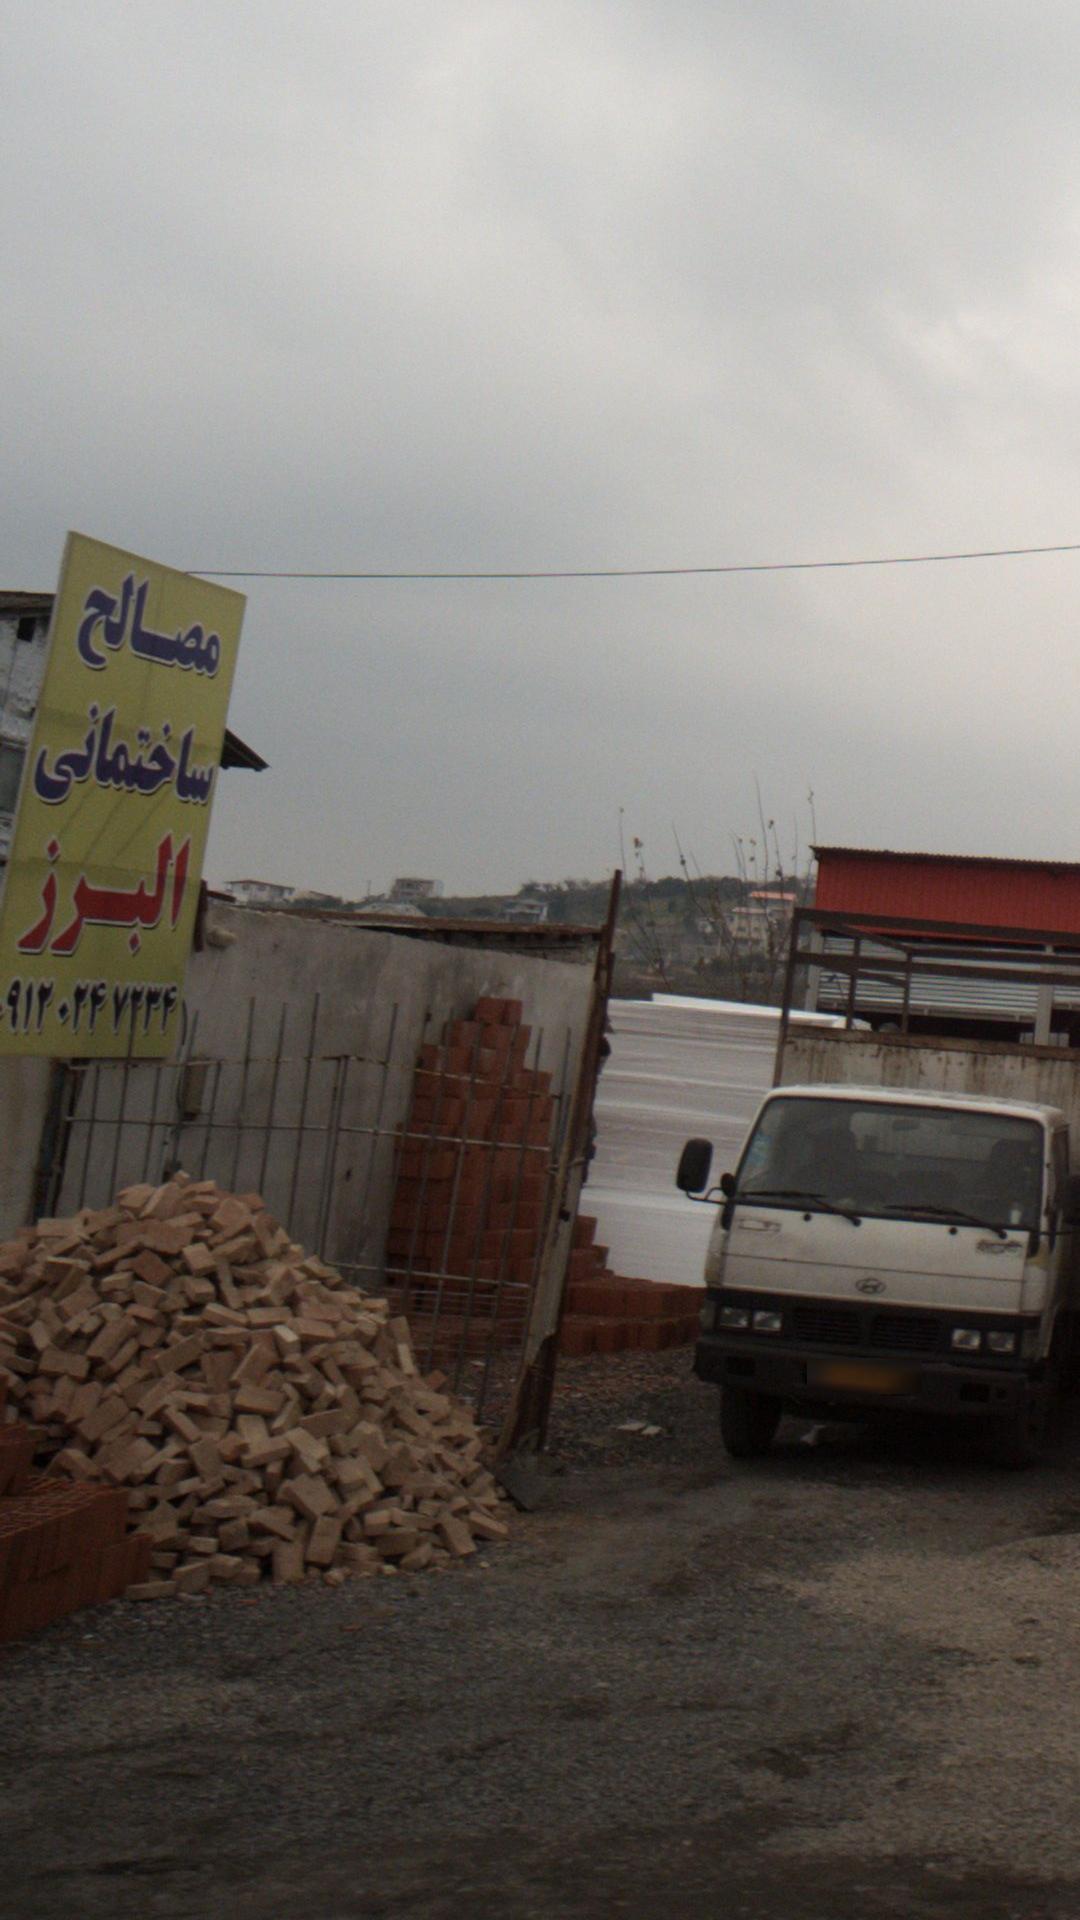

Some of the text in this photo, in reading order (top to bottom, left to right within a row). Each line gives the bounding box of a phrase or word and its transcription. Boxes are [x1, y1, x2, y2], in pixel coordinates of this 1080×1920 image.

[78, 574, 220, 677] مصالح
[35, 707, 214, 803] ساختمانی
[19, 834, 192, 955] البرز
